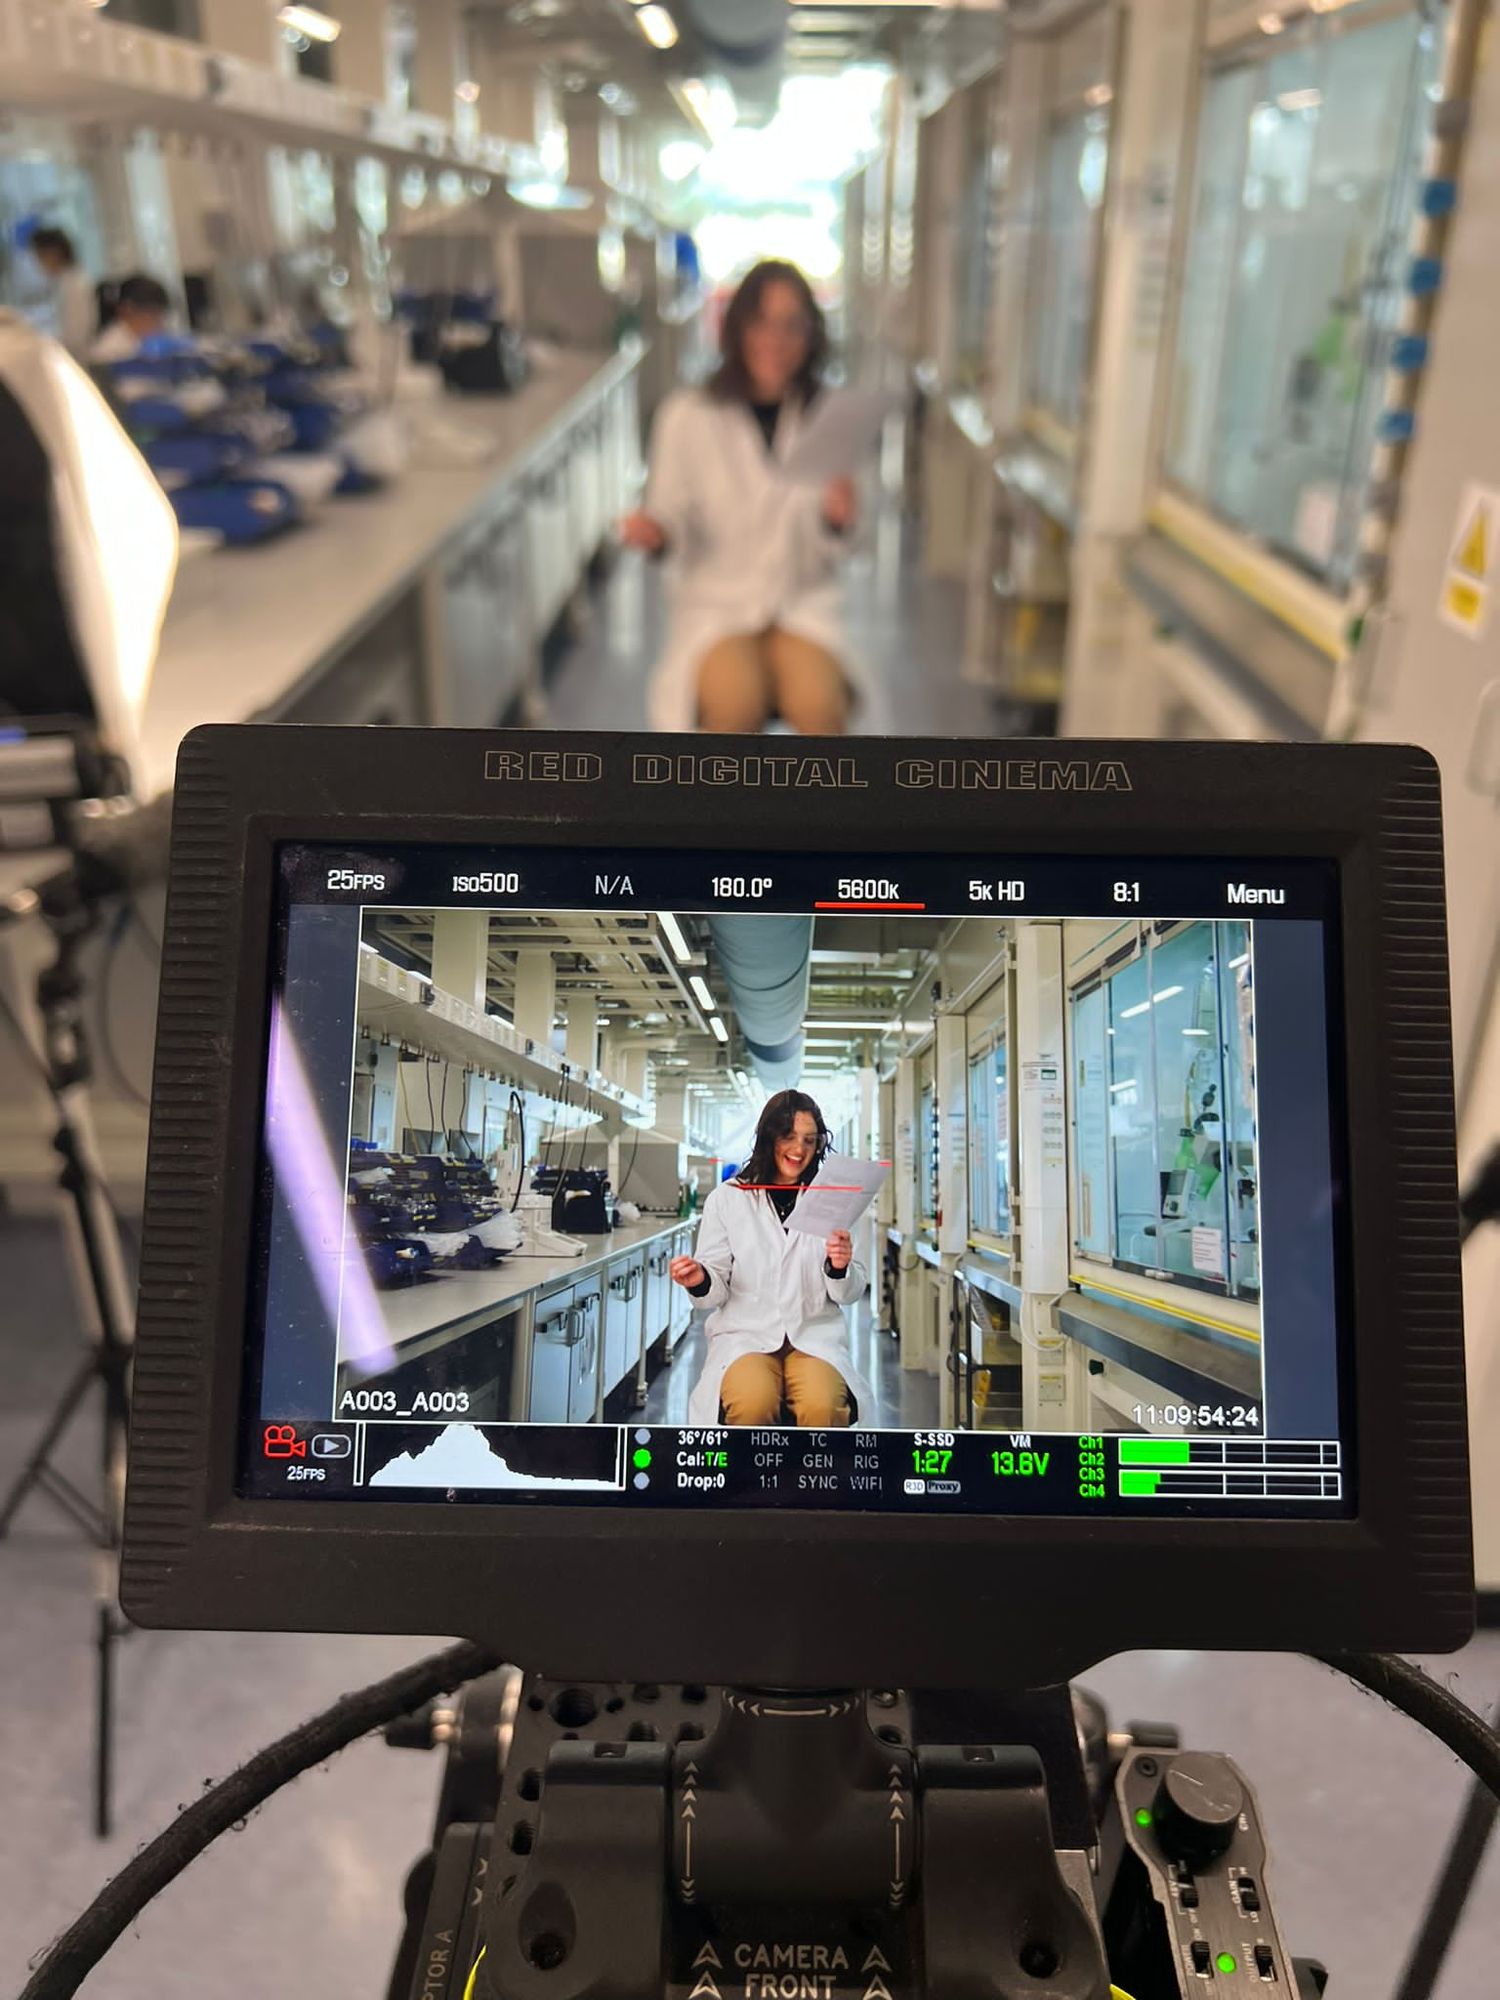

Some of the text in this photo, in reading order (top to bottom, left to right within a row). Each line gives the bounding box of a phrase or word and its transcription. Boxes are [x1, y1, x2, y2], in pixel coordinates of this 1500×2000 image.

[484, 750, 1132, 791] RED DIGITAL CINEMA
[326, 868, 386, 892] 25FPS
[595, 874, 634, 896] N/A
[998, 880, 1025, 902] HD
[1113, 881, 1141, 903] 8:1
[1227, 882, 1285, 905] Menu
[338, 1390, 470, 1416] A003_A003
[1131, 1404, 1259, 1427] 11:09:54:24
[809, 1433, 828, 1447] TC
[914, 1432, 955, 1447] S-SSD
[1010, 1434, 1031, 1448] VM
[1078, 1435, 1104, 1449] Ch1
[754, 1454, 879, 1469] OFF GEN RIG
[912, 1450, 953, 1474] 1:27
[1079, 1452, 1105, 1466] Ch2
[287, 1465, 326, 1482] 25FPS
[677, 1472, 725, 1491] Drop:0
[760, 1475, 883, 1491] 1:1 SYNC WIFI
[1079, 1467, 1105, 1482] Ch3
[928, 1480, 960, 1492] Proxy
[1079, 1483, 1105, 1498] Ch4
[1228, 1880, 1241, 1904] GAIN
[734, 1943, 849, 1969] CAMERA
[1241, 1942, 1258, 1984] OUTPUT
[745, 1973, 837, 1999] FRONT
